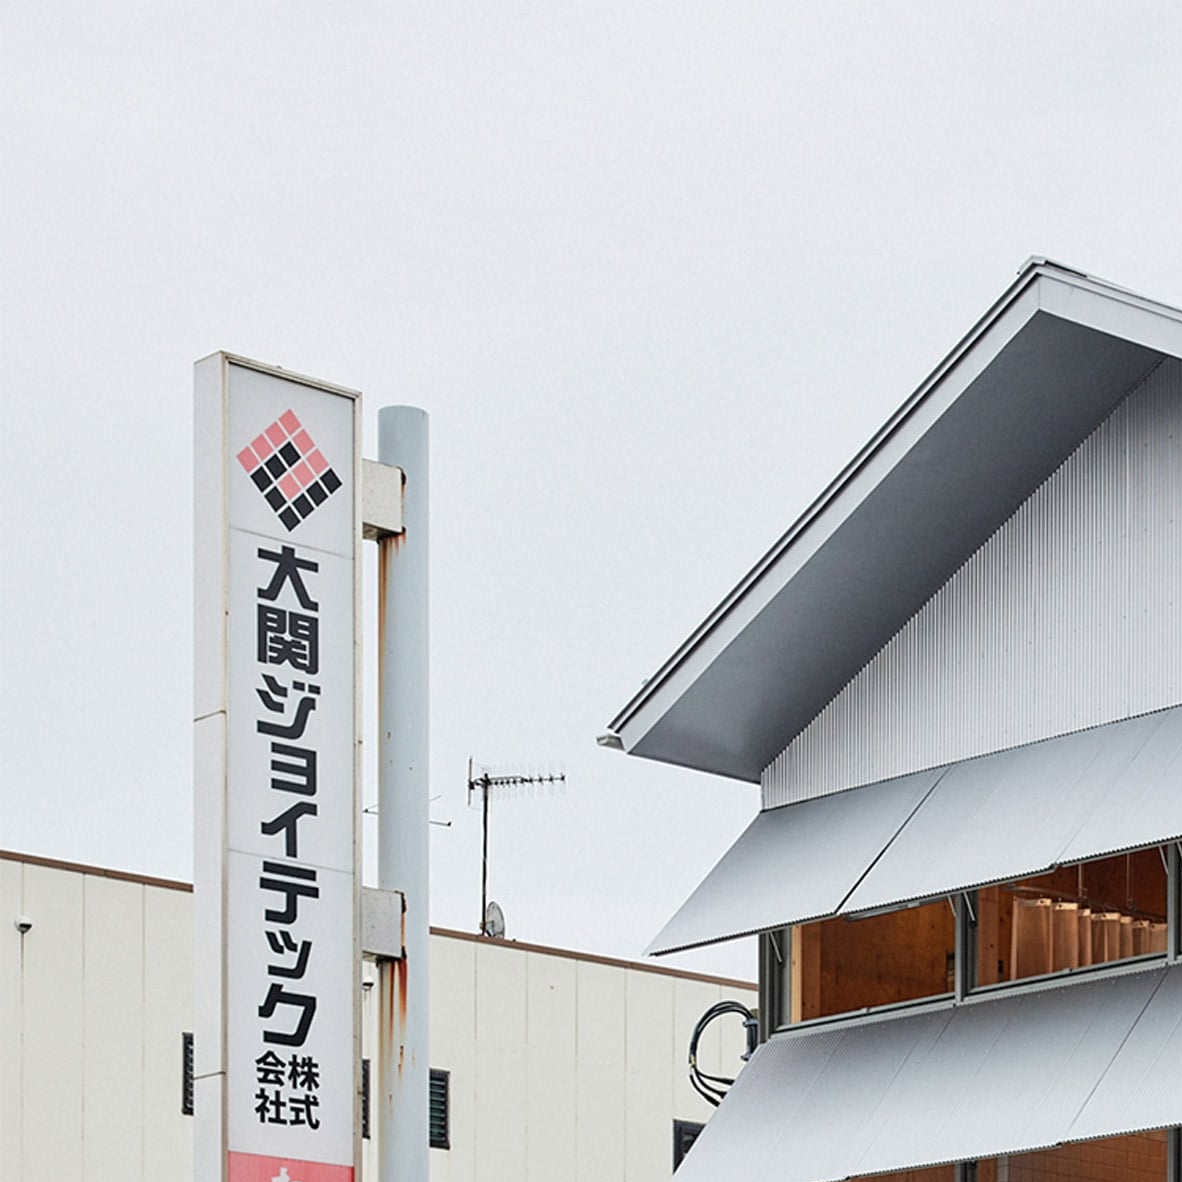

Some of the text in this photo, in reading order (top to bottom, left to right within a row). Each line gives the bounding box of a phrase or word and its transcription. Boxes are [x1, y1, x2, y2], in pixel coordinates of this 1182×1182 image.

[256, 544, 322, 1047] 大関ジョイテック
